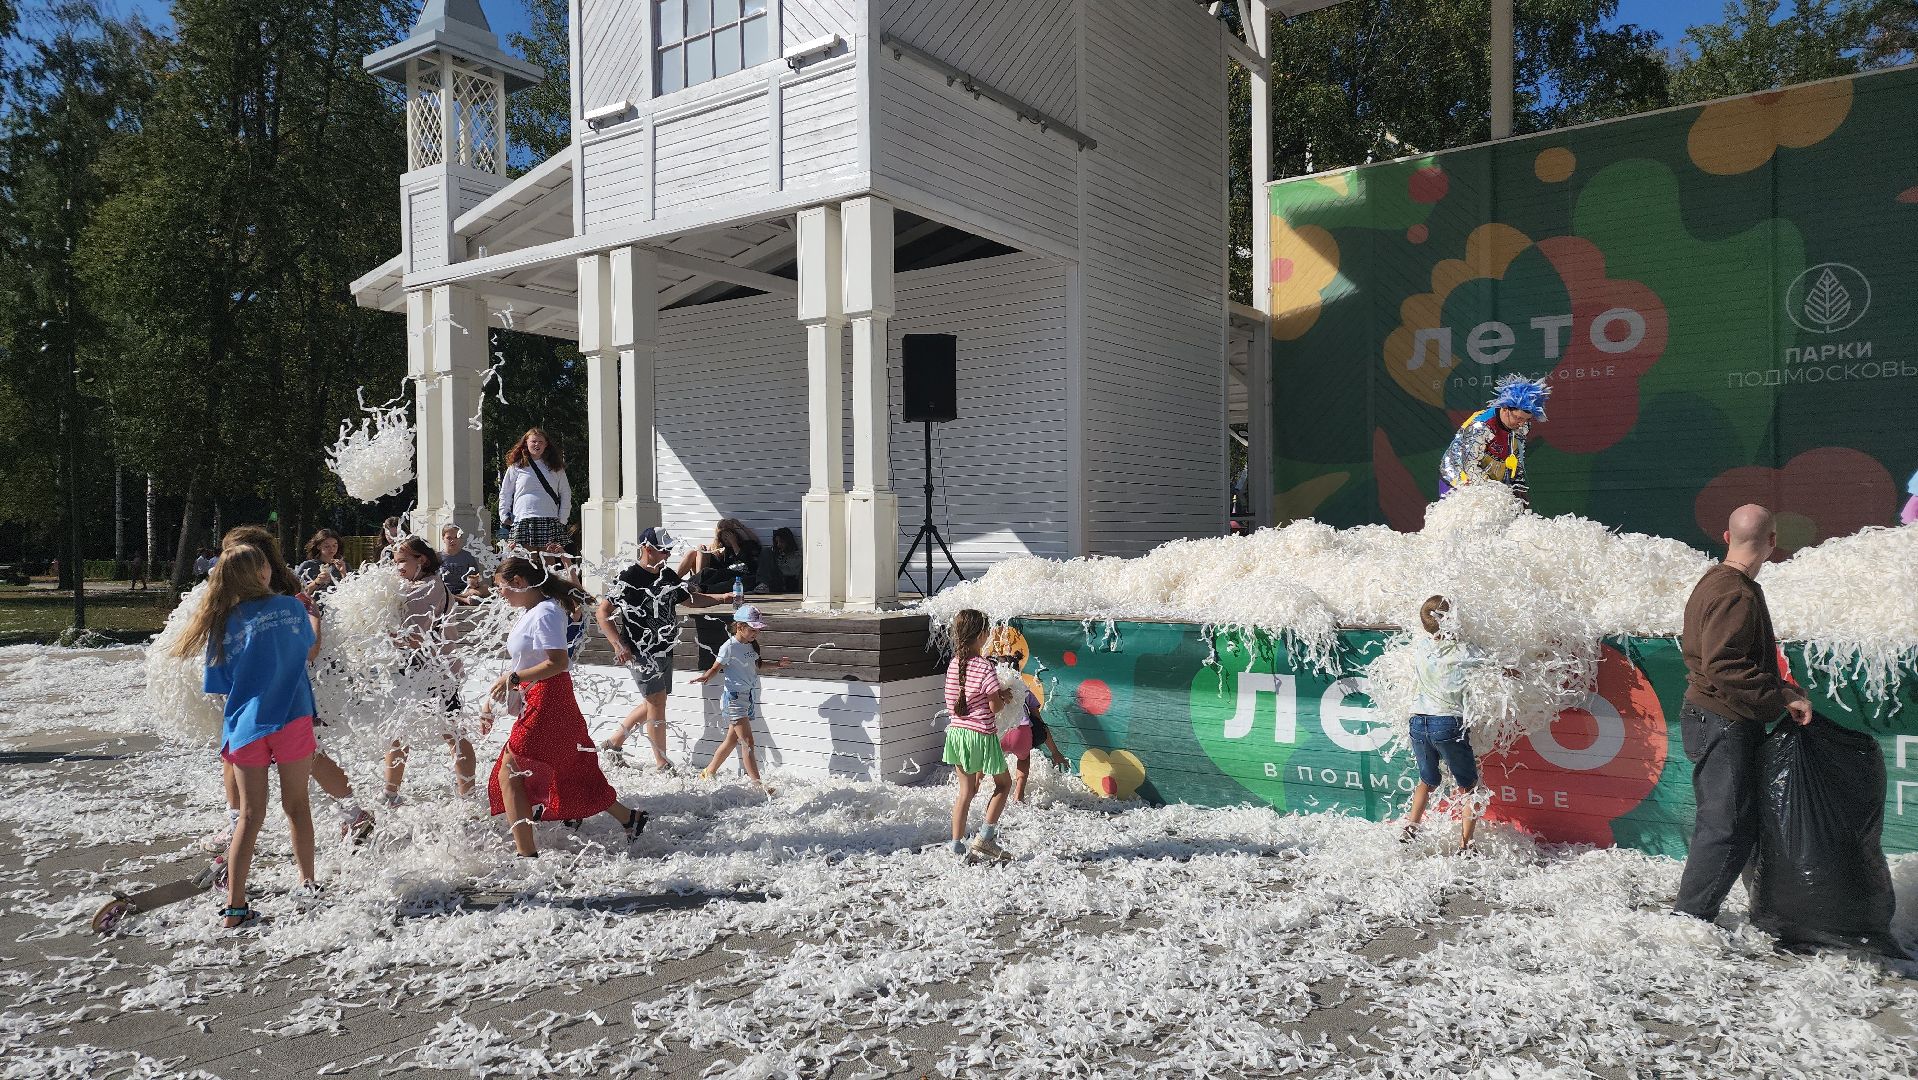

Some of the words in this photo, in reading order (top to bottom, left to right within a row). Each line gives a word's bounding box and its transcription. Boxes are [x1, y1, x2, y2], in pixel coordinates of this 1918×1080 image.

[1406, 307, 1646, 371] лето
[1785, 341, 1872, 364] ПАРКИ
[1453, 365, 1616, 389] ПОДСКОВЬЕ
[1223, 671, 1626, 770] лео
[1297, 765, 1570, 809] ПОДМОВЬЕ
